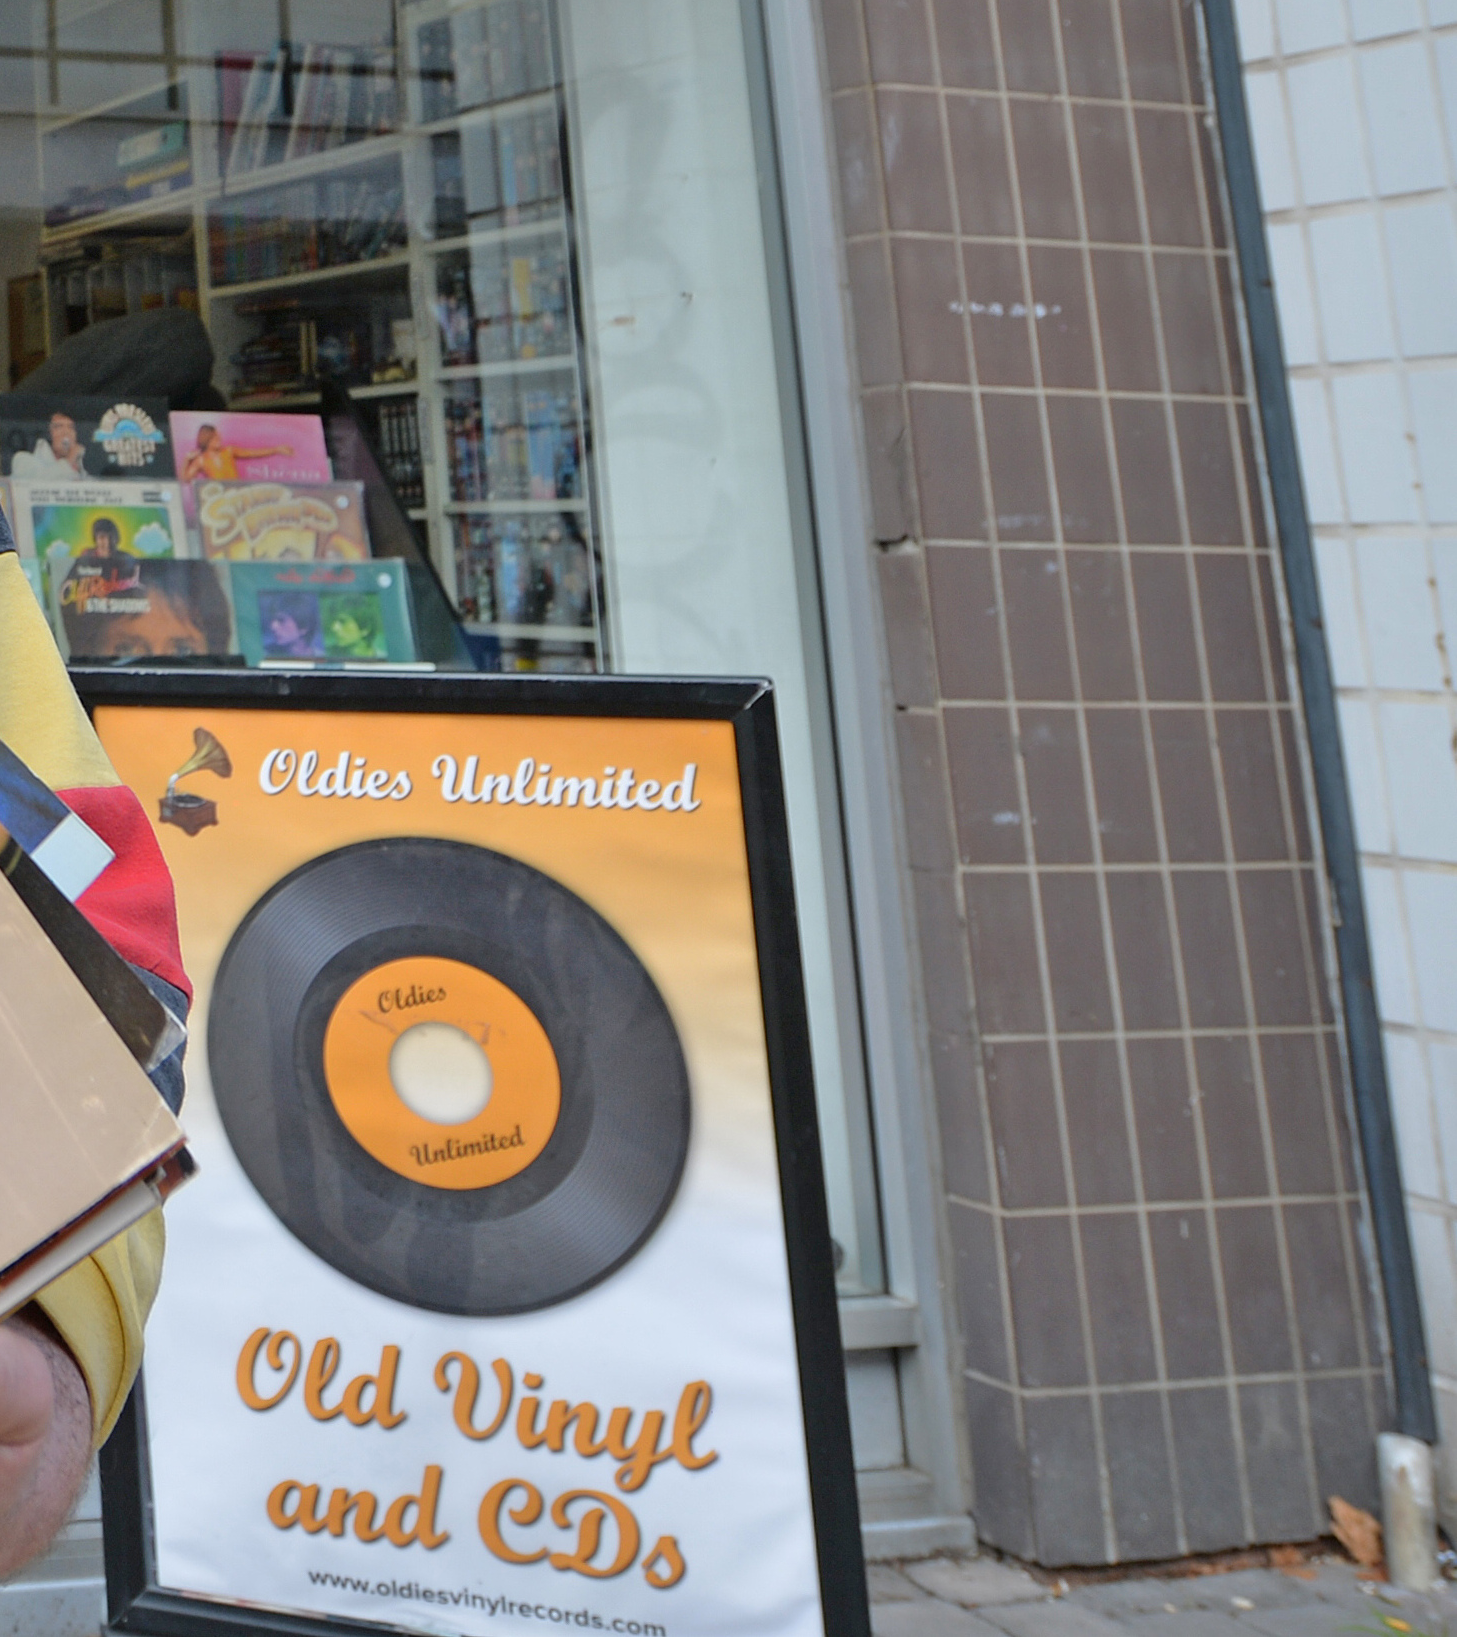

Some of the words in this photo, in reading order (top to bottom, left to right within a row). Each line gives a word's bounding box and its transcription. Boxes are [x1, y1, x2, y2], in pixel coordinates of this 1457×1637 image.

[259, 748, 413, 802] Oldies
[431, 754, 702, 812] Unlimited
[376, 984, 448, 1015] Oldies
[409, 1125, 526, 1168] Unlimited
[236, 1328, 408, 1429] Old
[434, 1351, 719, 1492] Vinyl
[266, 1465, 449, 1550] and
[477, 1478, 686, 1589] CDs
[308, 1570, 667, 1637] www.oldiesvinylrecords.com
